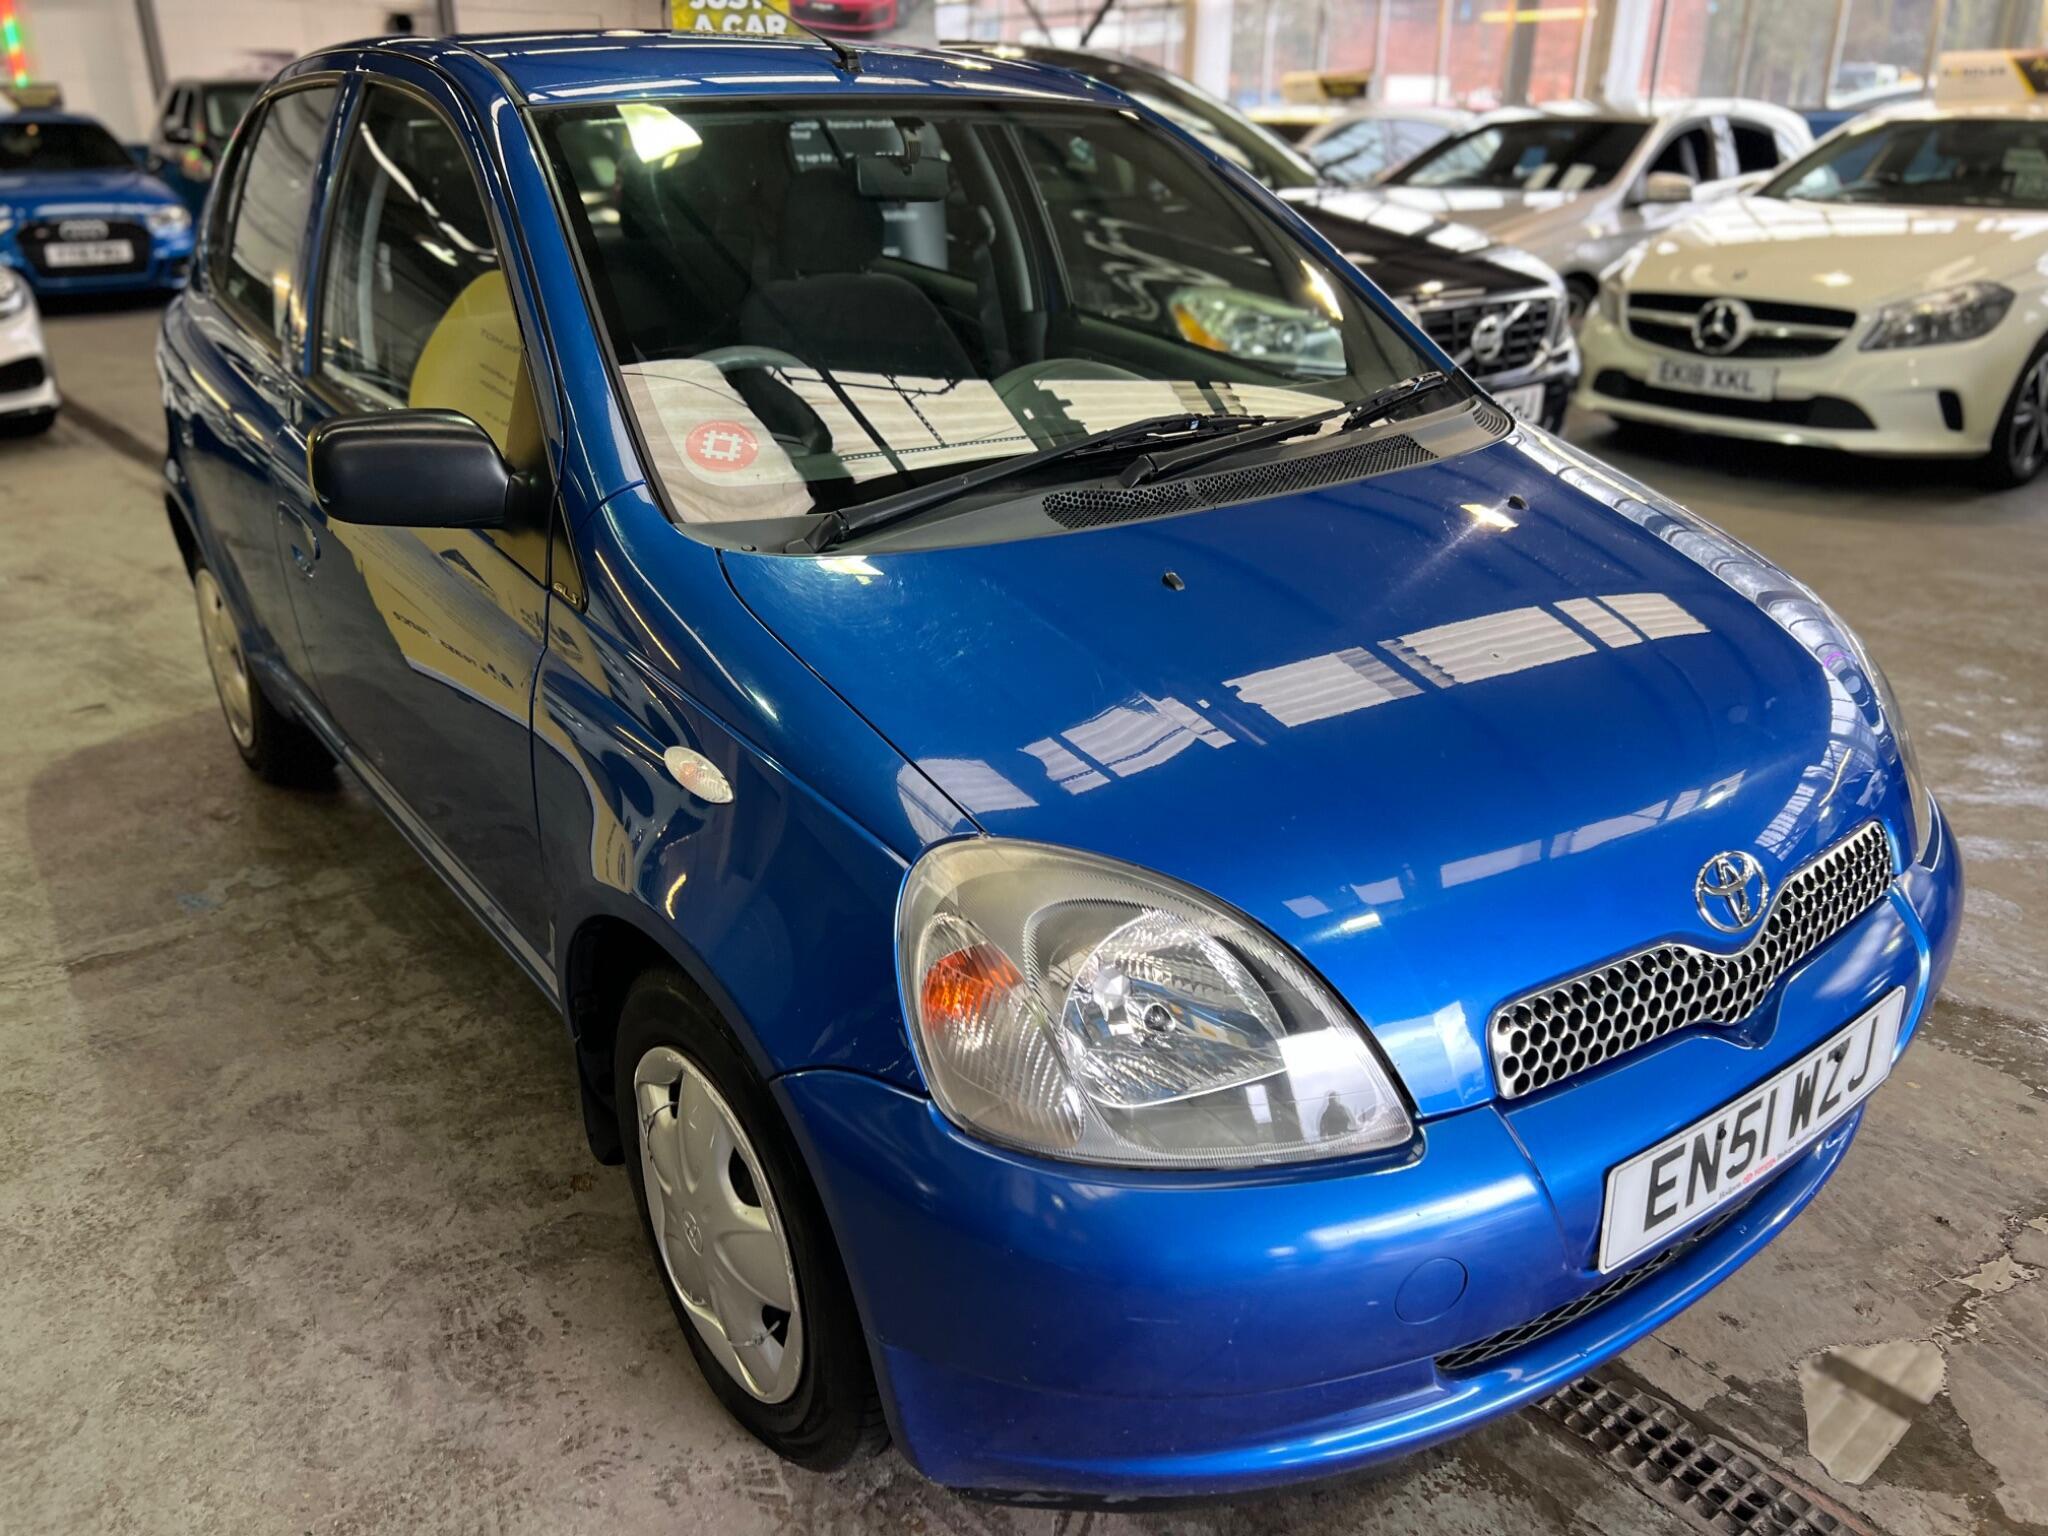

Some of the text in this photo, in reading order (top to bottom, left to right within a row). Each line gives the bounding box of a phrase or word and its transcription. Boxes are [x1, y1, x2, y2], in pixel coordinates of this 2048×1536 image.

[694, 14, 787, 34] A CAR
[1643, 1087, 1778, 1232] EN51
[1788, 1015, 1878, 1141] WZJ
